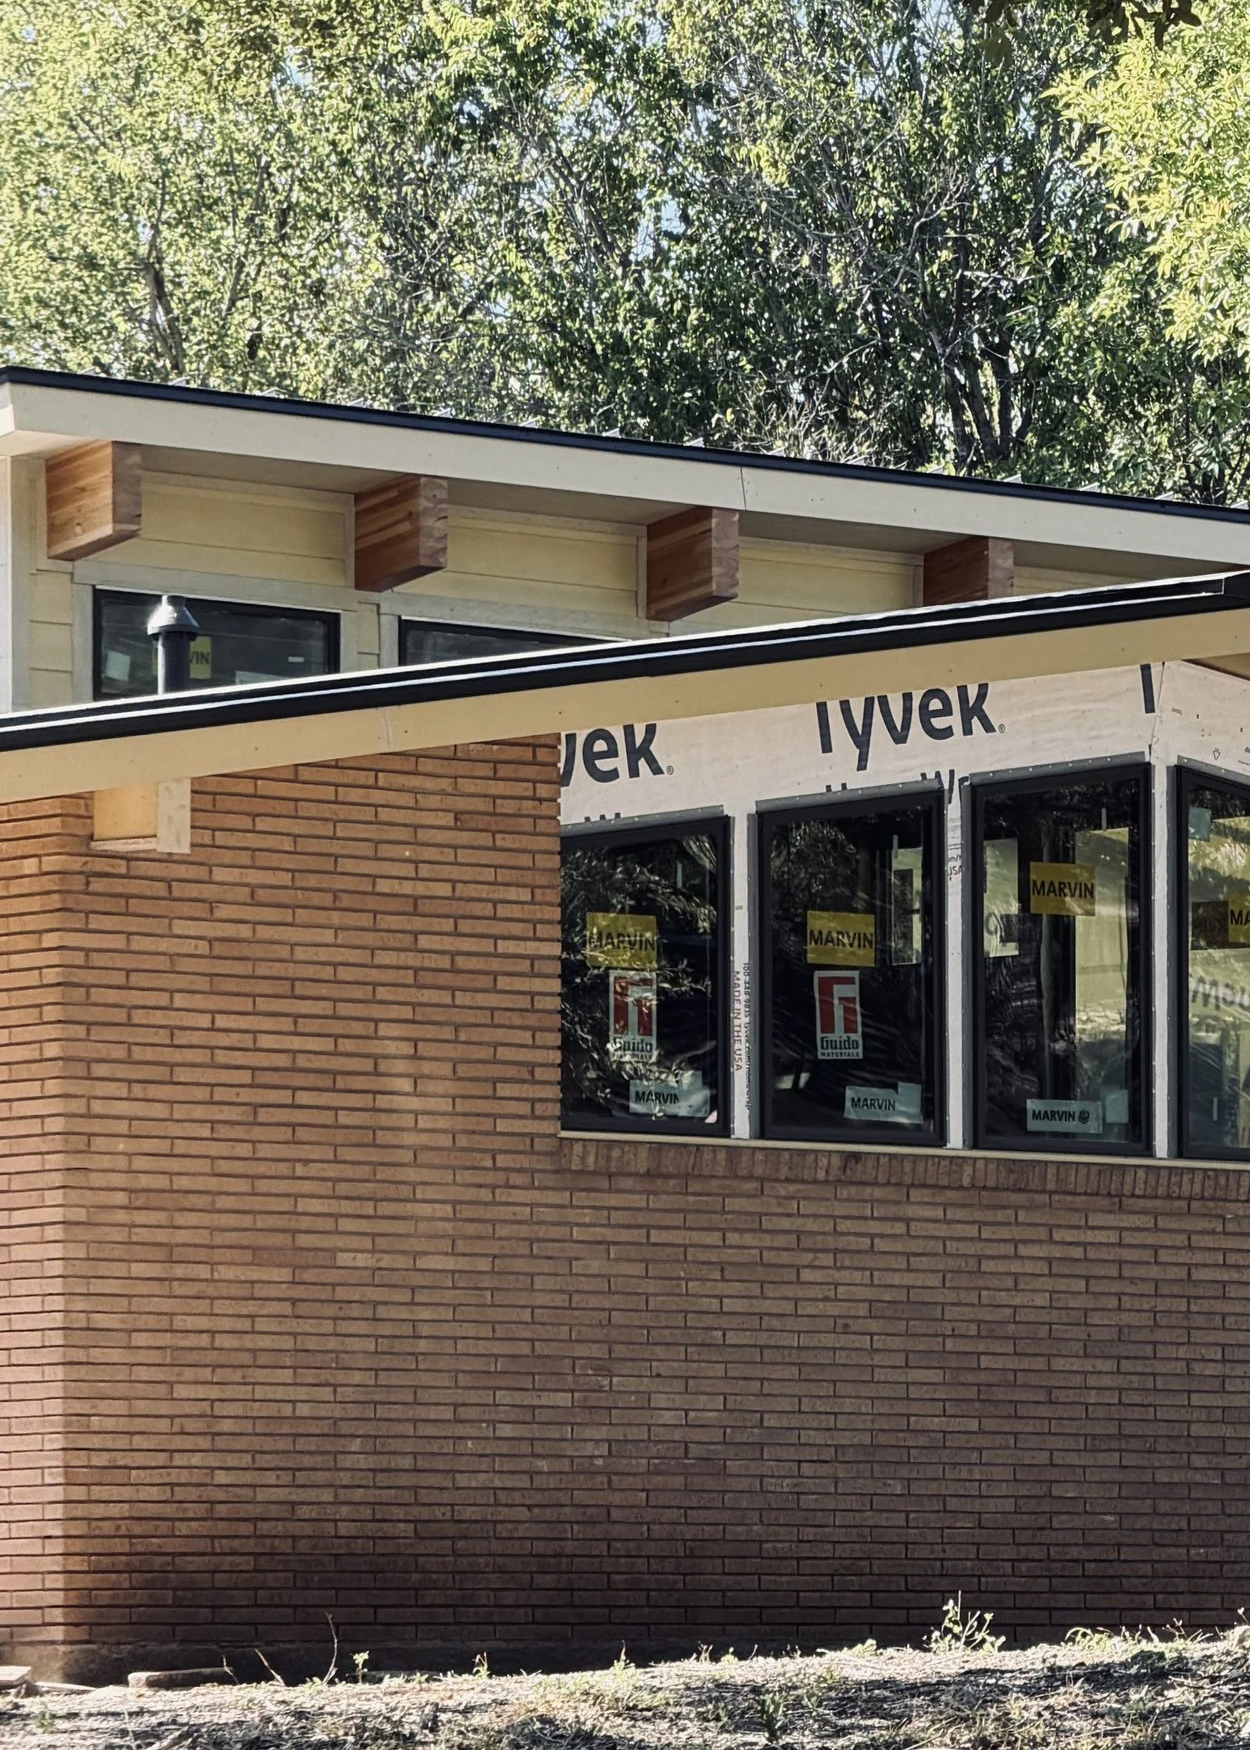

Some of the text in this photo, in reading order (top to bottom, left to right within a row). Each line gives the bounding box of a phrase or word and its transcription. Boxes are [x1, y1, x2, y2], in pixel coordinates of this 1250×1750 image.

[1031, 879, 1094, 899] MARVIN
[588, 931, 655, 951] MARVIN
[809, 929, 873, 949] MARVIN
[732, 971, 743, 1071] MADE IN THE USA
[820, 1035, 859, 1050] Guido
[635, 1090, 680, 1104] MARVIN
[851, 1097, 896, 1111] MARVIN
[1031, 1109, 1075, 1122] MARVIN
